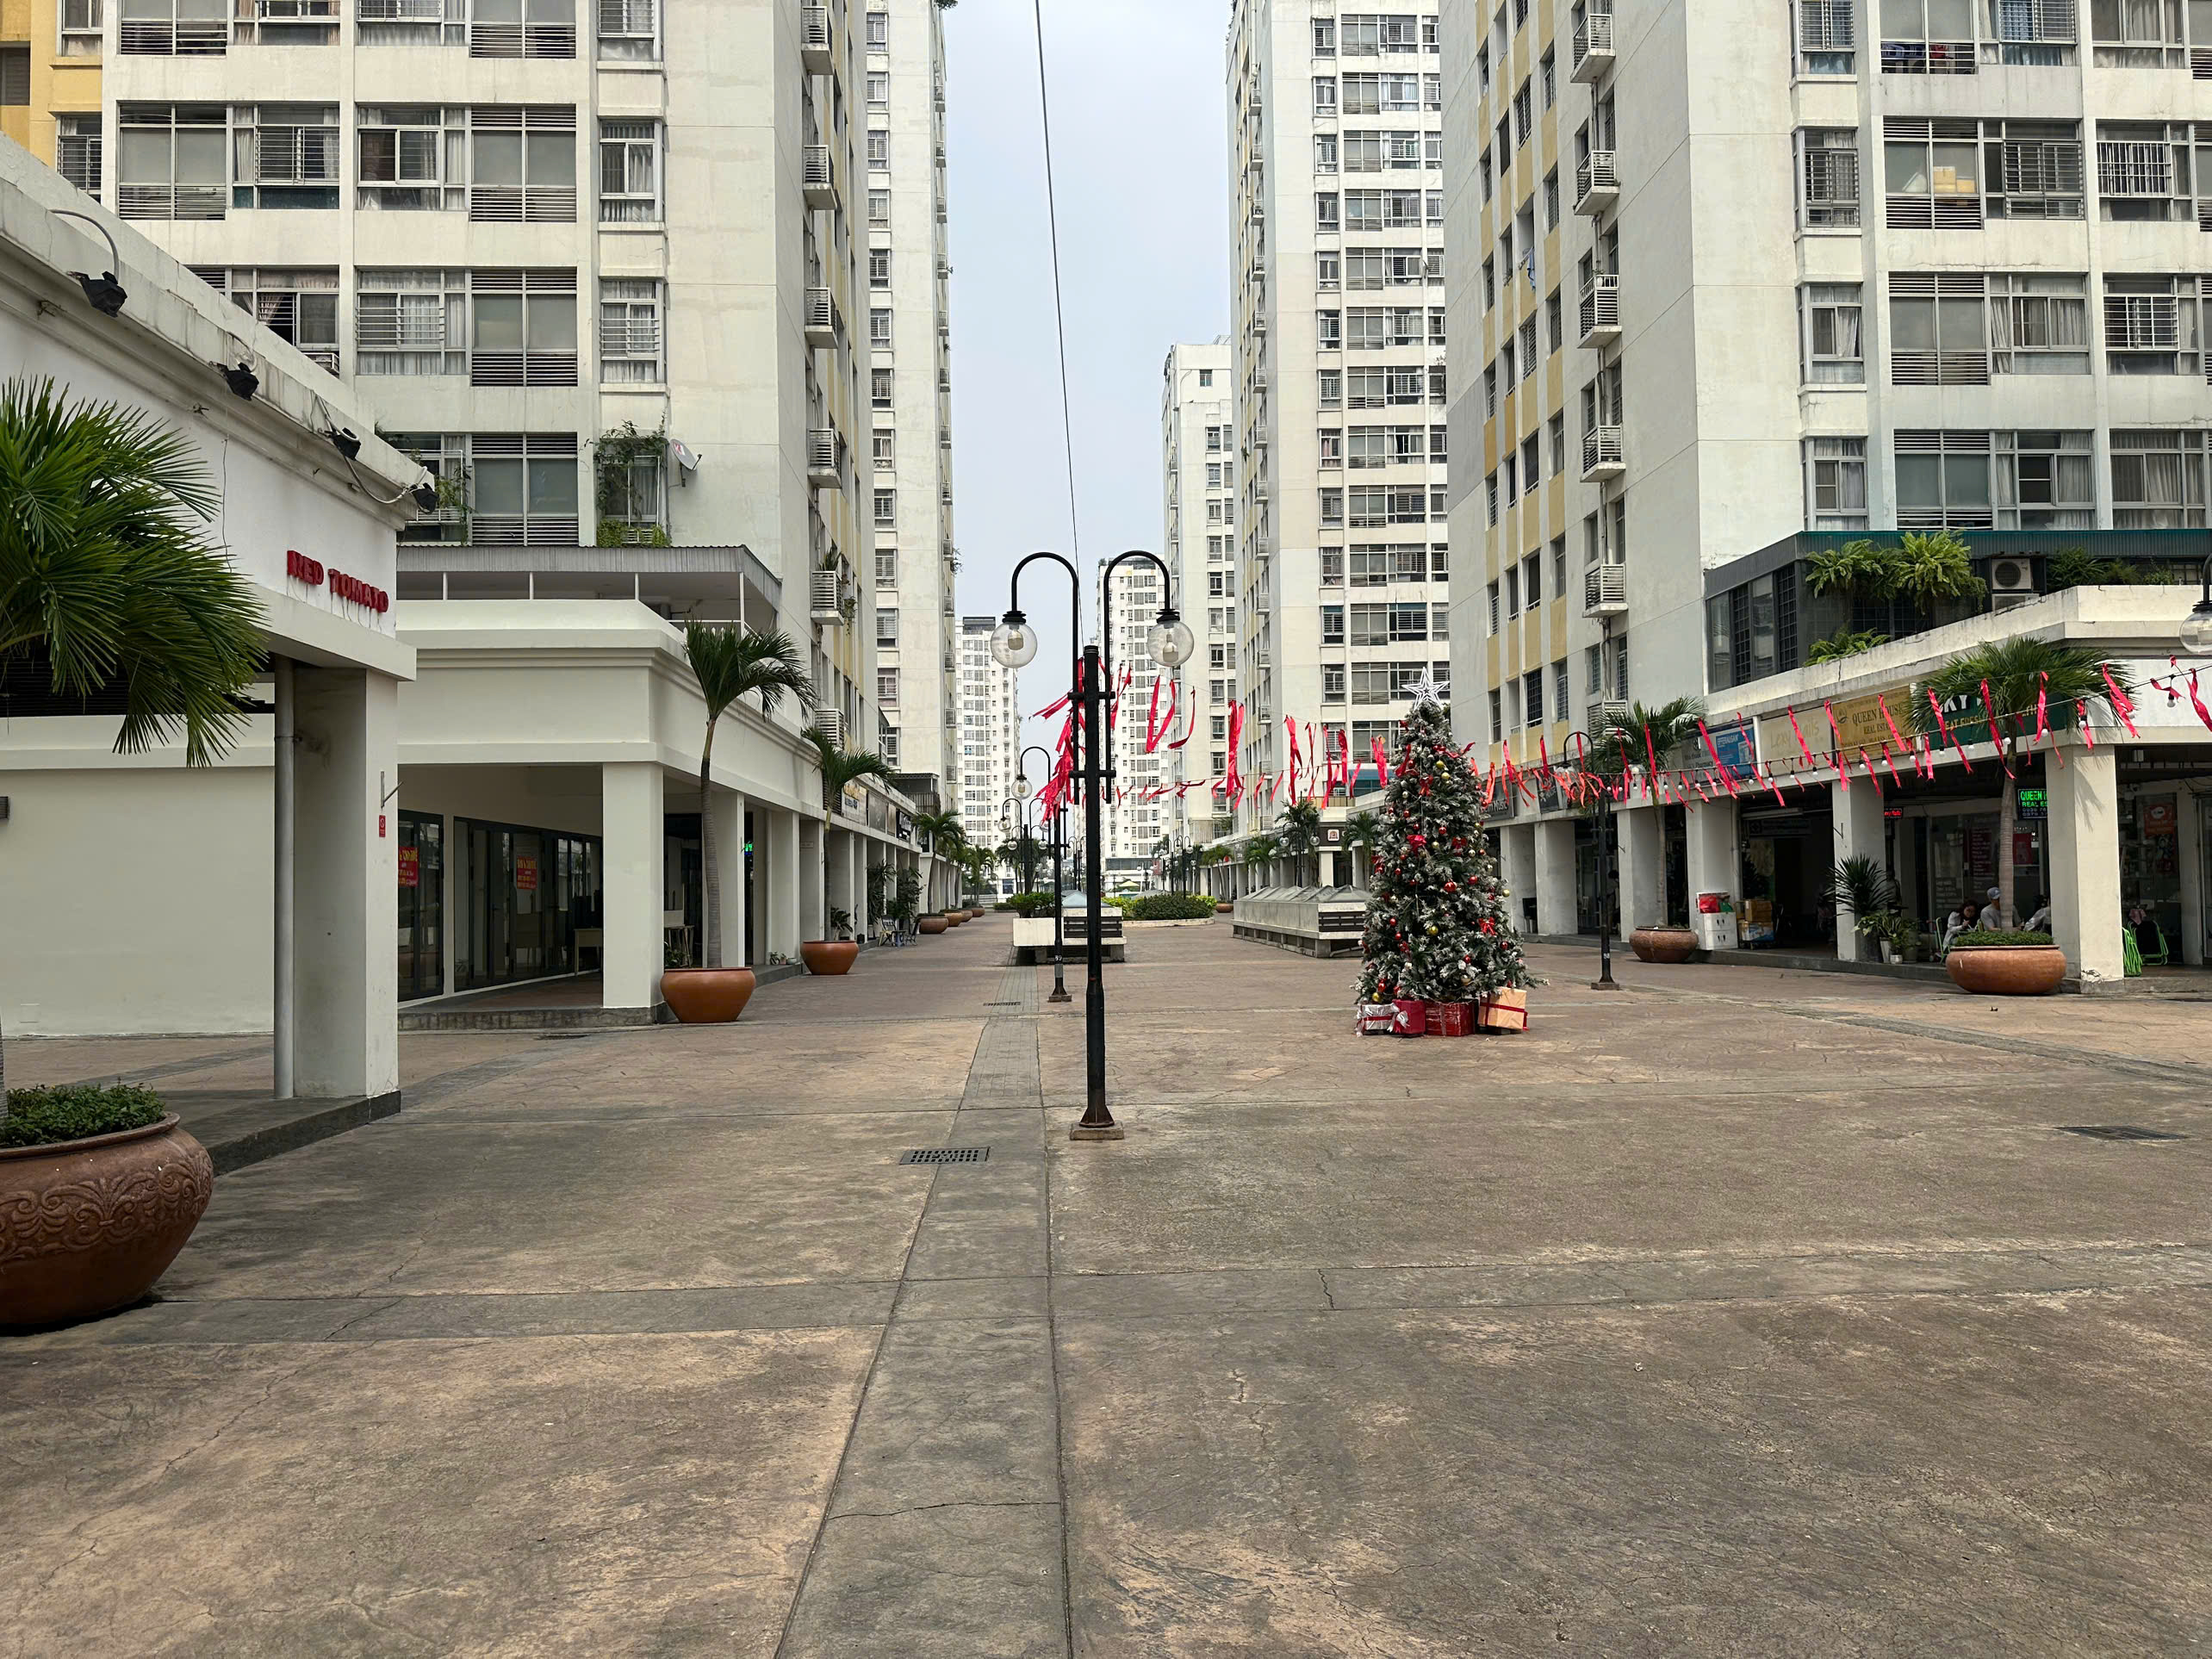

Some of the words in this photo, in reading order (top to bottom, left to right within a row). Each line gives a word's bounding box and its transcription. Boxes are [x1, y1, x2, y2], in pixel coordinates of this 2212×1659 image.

[328, 569, 388, 612] TOMATO
[1852, 708, 1878, 726] QUEEN
[1864, 724, 1877, 736] REAL
[2021, 791, 2042, 801] QUEEN
